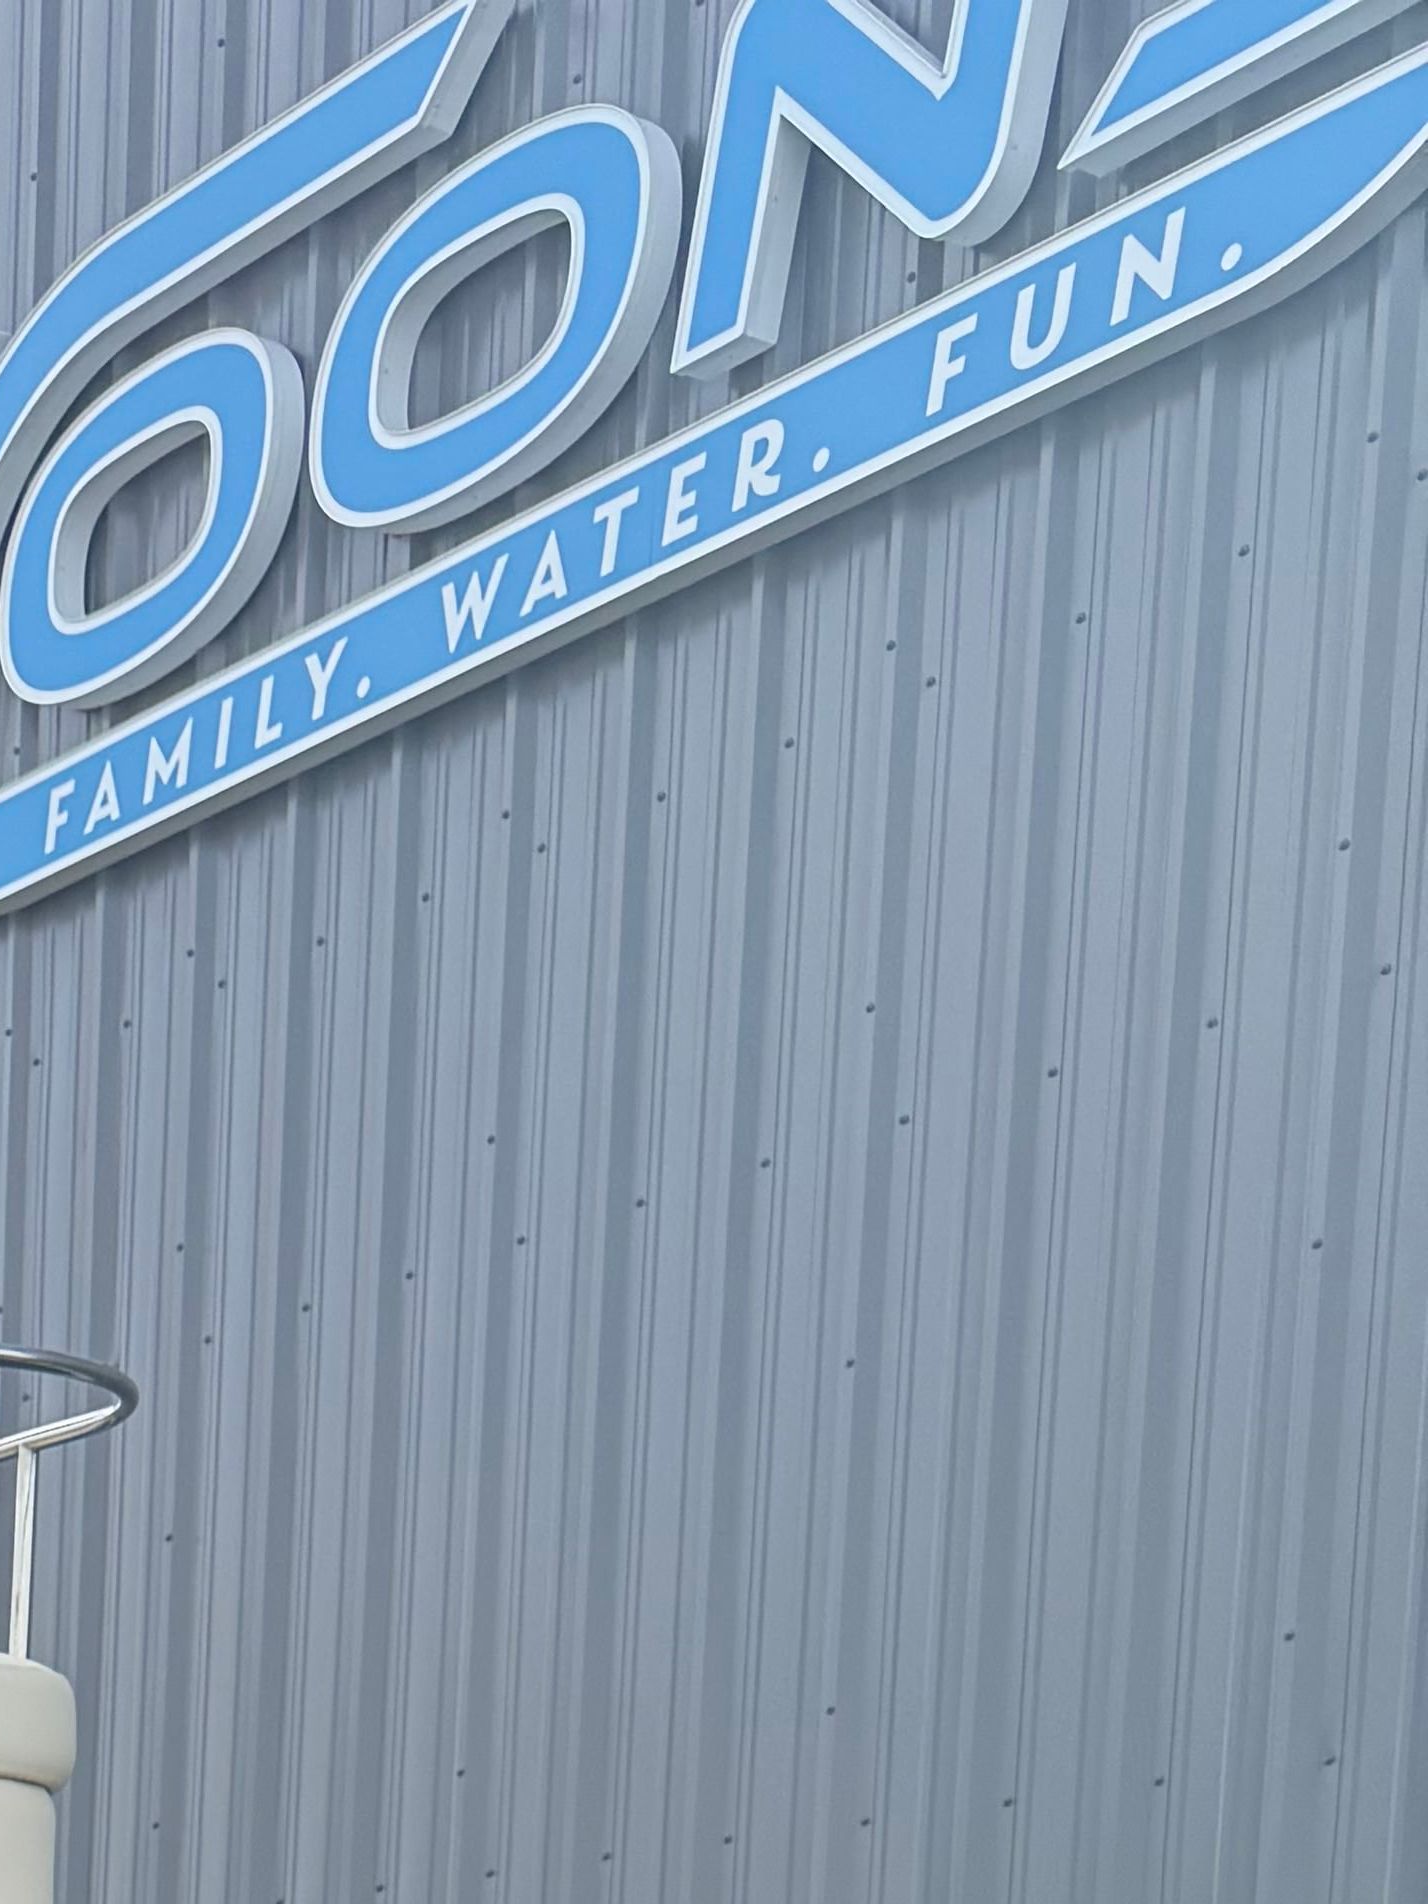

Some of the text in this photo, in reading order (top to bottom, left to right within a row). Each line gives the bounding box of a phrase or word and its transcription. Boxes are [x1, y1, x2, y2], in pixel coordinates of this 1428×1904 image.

[44, 206, 1245, 856] FAMILY. WATER. FUN.
